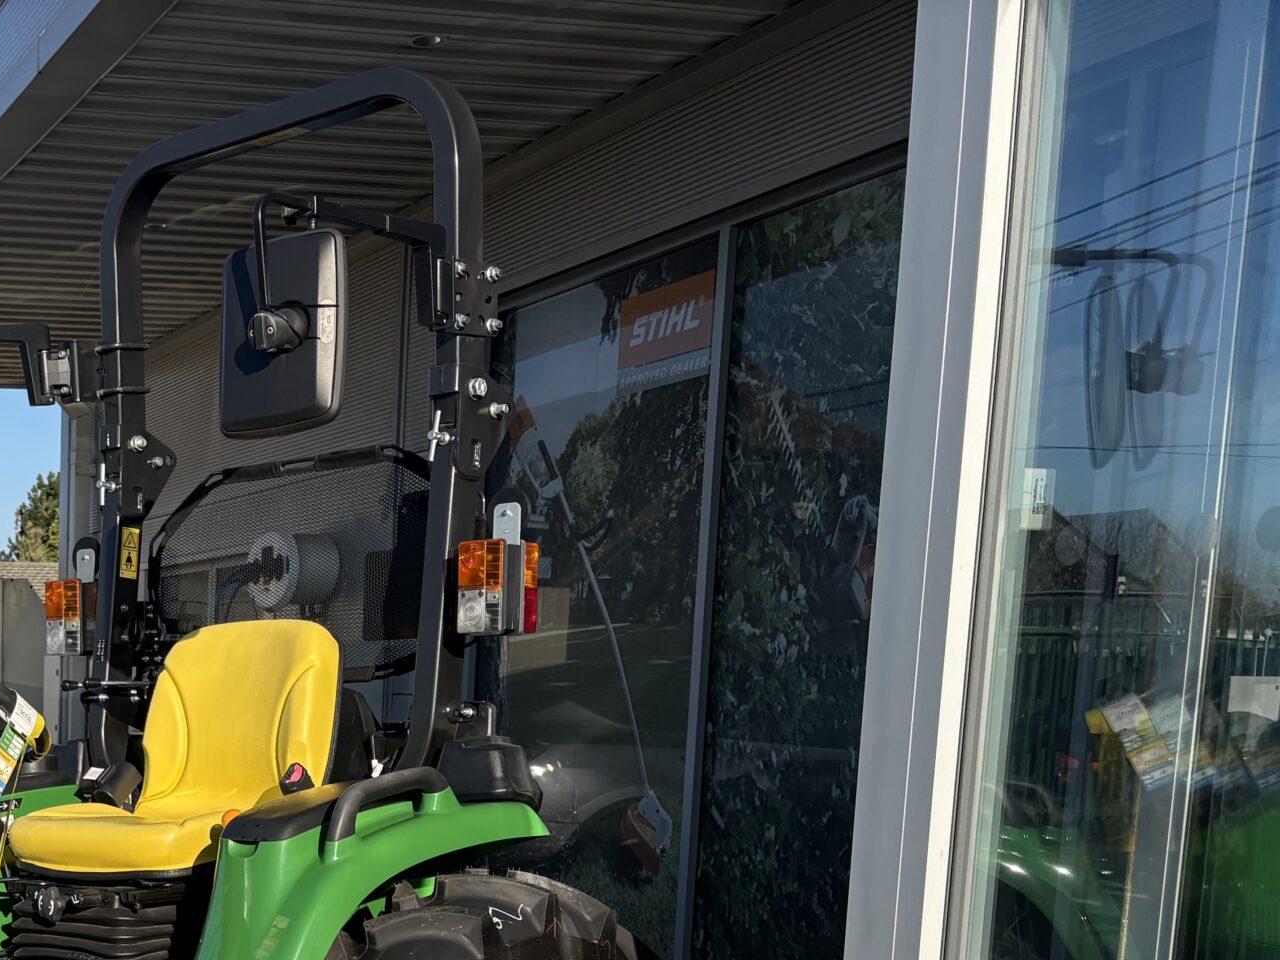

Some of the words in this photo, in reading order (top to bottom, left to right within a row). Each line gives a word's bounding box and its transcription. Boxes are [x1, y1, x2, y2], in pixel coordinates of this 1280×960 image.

[629, 299, 700, 347] STIHL
[619, 368, 667, 389] APPROVED
[670, 356, 708, 377] DEALER
